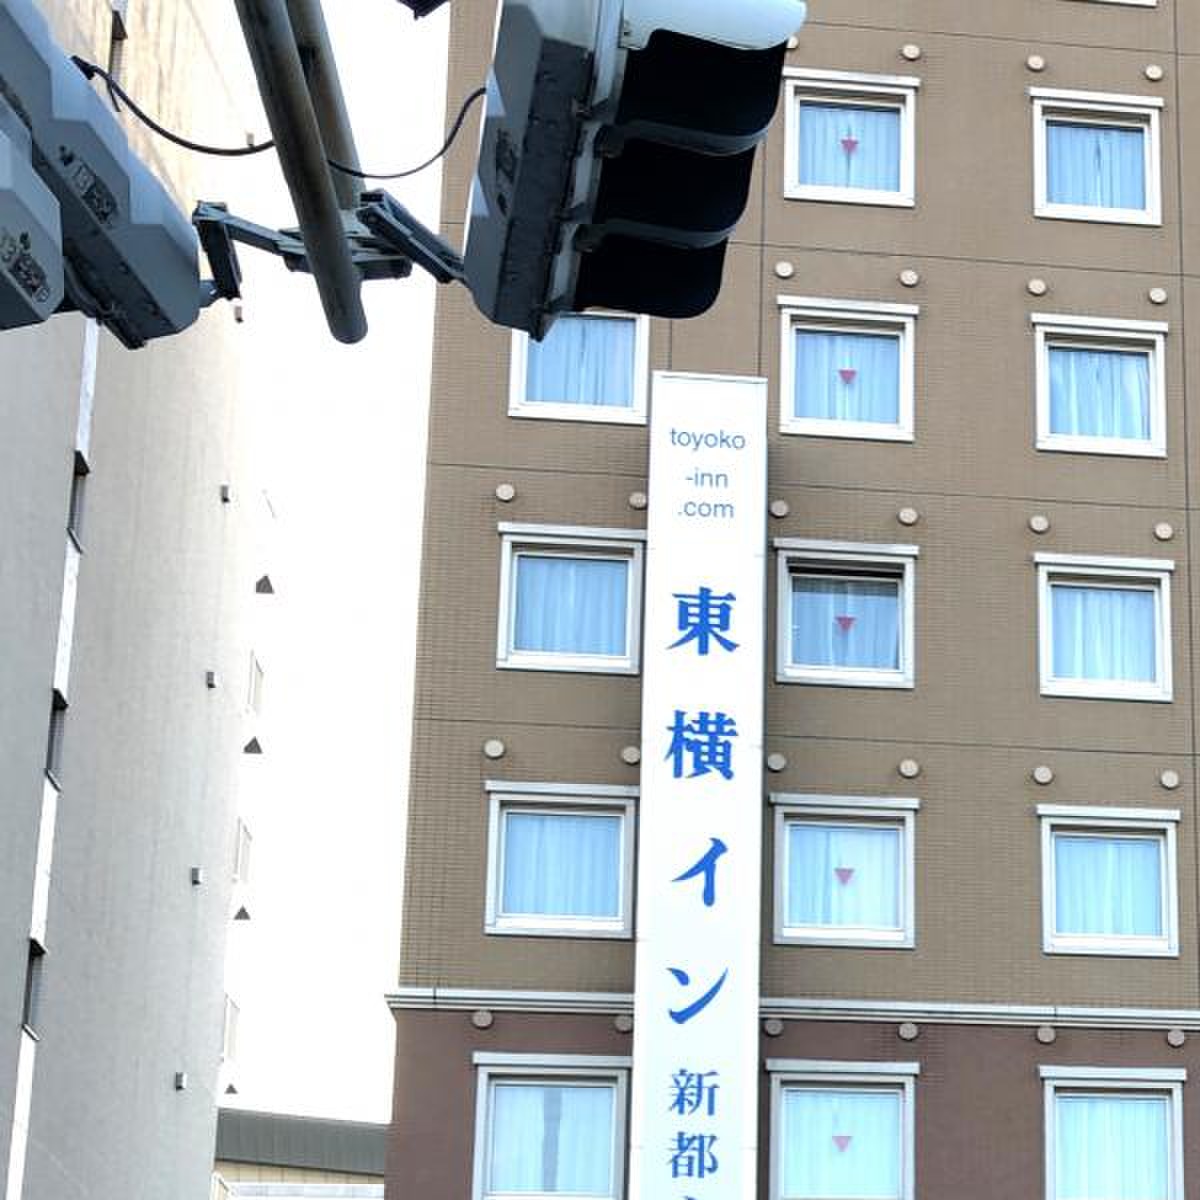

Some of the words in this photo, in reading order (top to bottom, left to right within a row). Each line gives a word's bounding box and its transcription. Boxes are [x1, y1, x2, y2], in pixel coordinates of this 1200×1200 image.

[669, 428, 746, 451] toyoko
[684, 467, 729, 488] -inn
[677, 500, 735, 519] .com
[665, 585, 740, 1025] 東横イン
